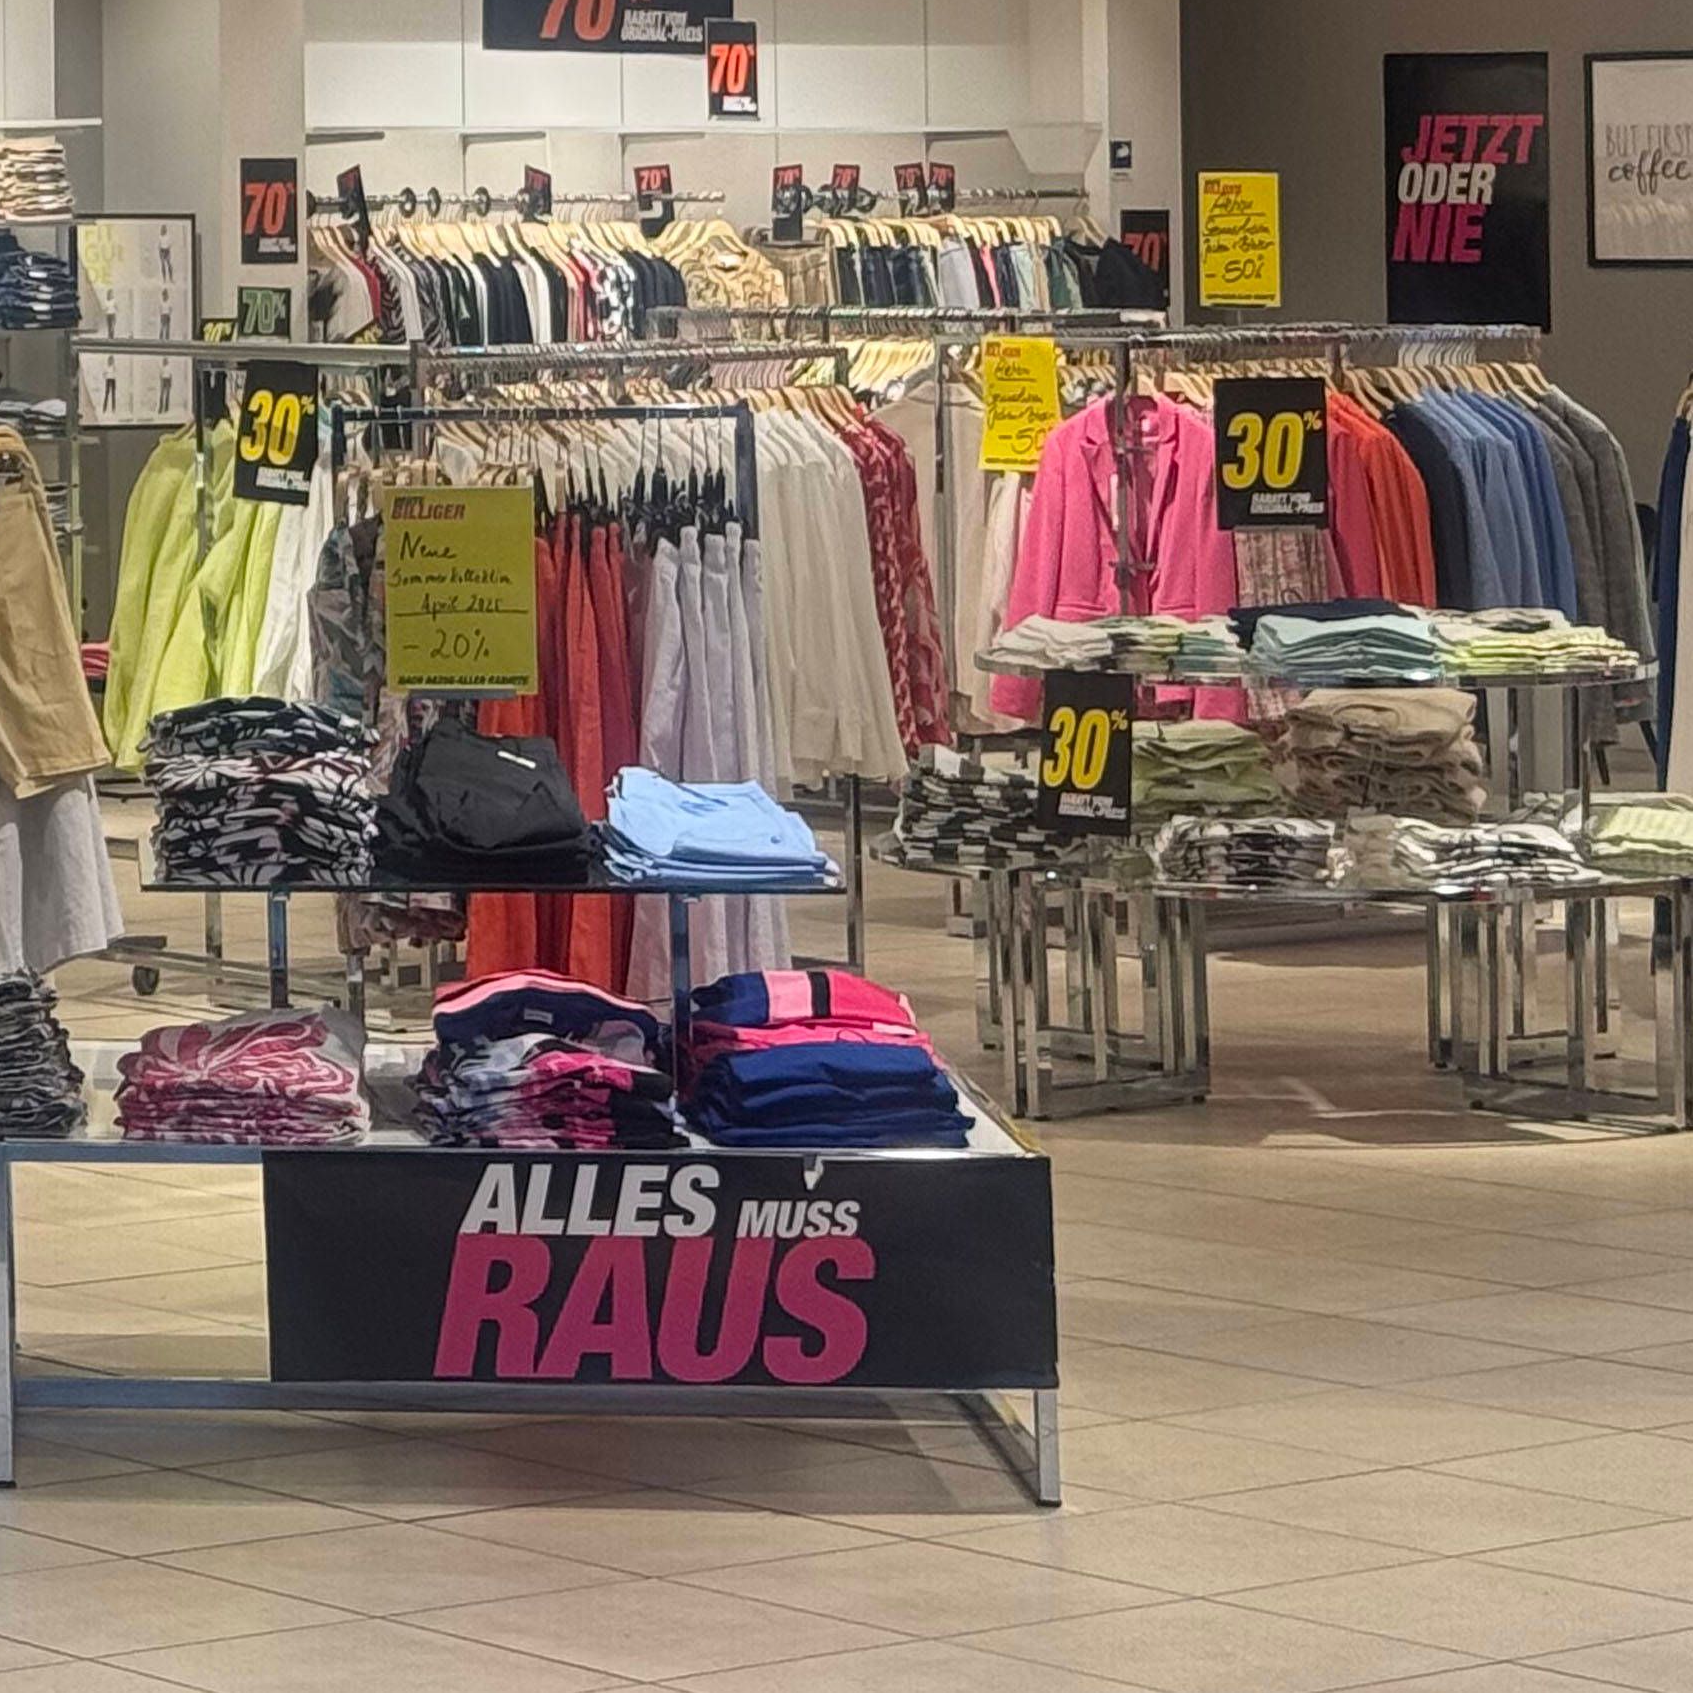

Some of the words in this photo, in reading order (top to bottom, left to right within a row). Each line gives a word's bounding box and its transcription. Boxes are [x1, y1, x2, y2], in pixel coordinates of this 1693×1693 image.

[1401, 113, 1543, 165] JETZT
[1605, 124, 1638, 157] BUT
[1397, 161, 1496, 207] ODER
[1608, 147, 1693, 196] coffee
[1391, 204, 1484, 264] NIE
[240, 389, 315, 466] 30%
[1222, 410, 1323, 489] 30%
[399, 531, 457, 560] Neue
[421, 592, 459, 621] April
[1043, 706, 1128, 790] 30%
[459, 1162, 720, 1238] ALLES
[736, 1199, 860, 1239] MUSS
[433, 1232, 877, 1385] RAUS
